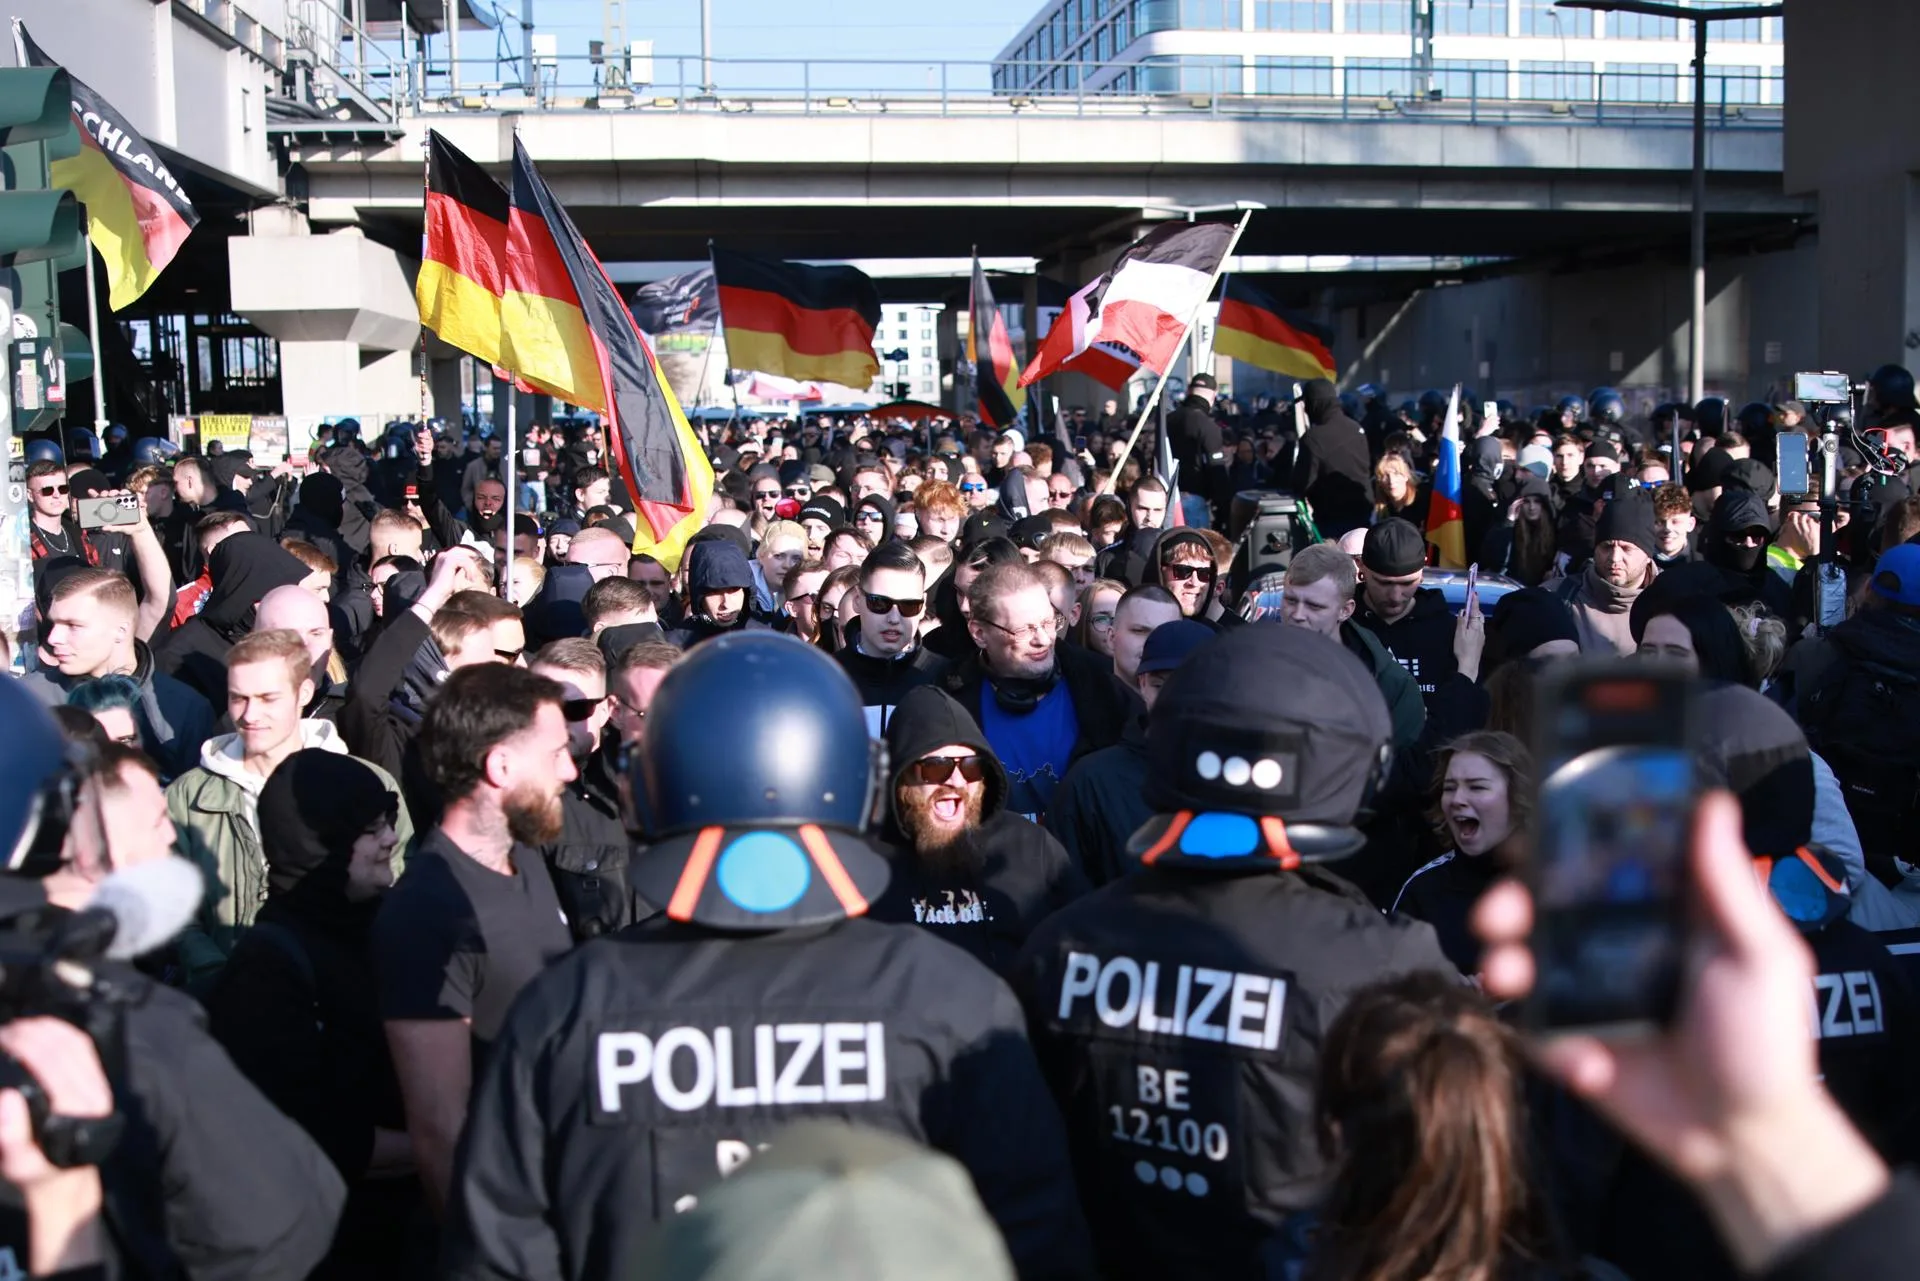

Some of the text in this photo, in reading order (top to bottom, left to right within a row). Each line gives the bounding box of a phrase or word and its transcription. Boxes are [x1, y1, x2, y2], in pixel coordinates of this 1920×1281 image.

[202, 416, 249, 424] STREET FOOD
[202, 424, 248, 432] FESTIVAL
[1059, 951, 1287, 1050] POLIZEI
[598, 1021, 886, 1112] POLIZEI
[1137, 1065, 1191, 1111] BE
[1109, 1104, 1229, 1161] 12100
